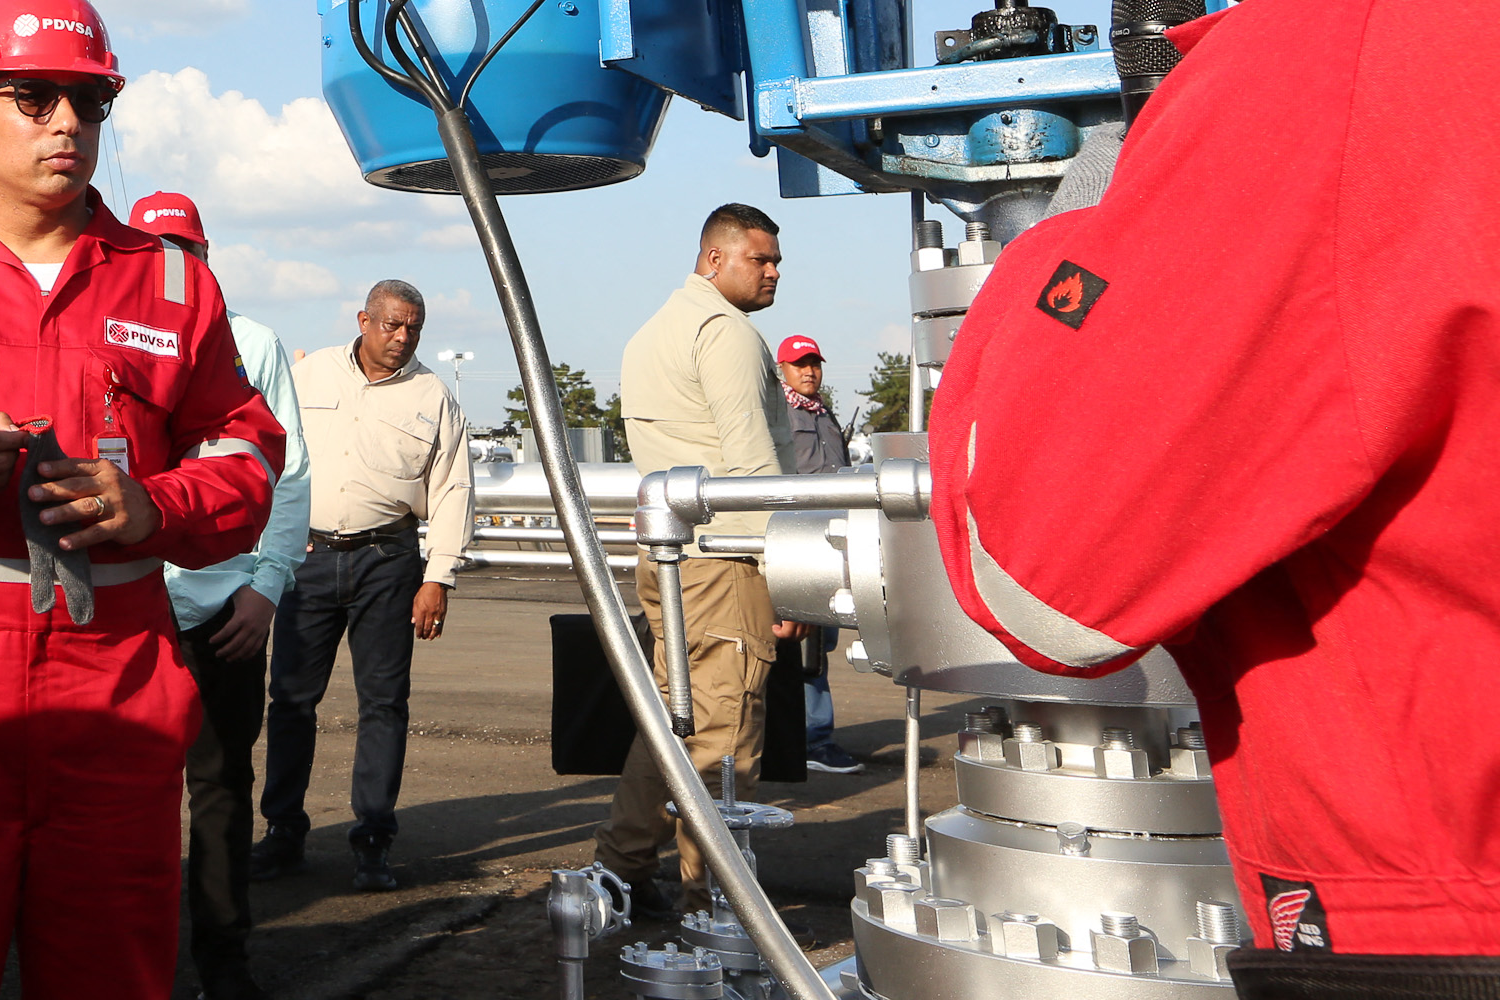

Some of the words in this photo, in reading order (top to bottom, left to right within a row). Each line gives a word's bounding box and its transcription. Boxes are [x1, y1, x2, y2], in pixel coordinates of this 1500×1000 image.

[42, 18, 94, 38] PDVSA
[156, 208, 187, 218] PDVSA
[131, 330, 176, 349] PDVSA
